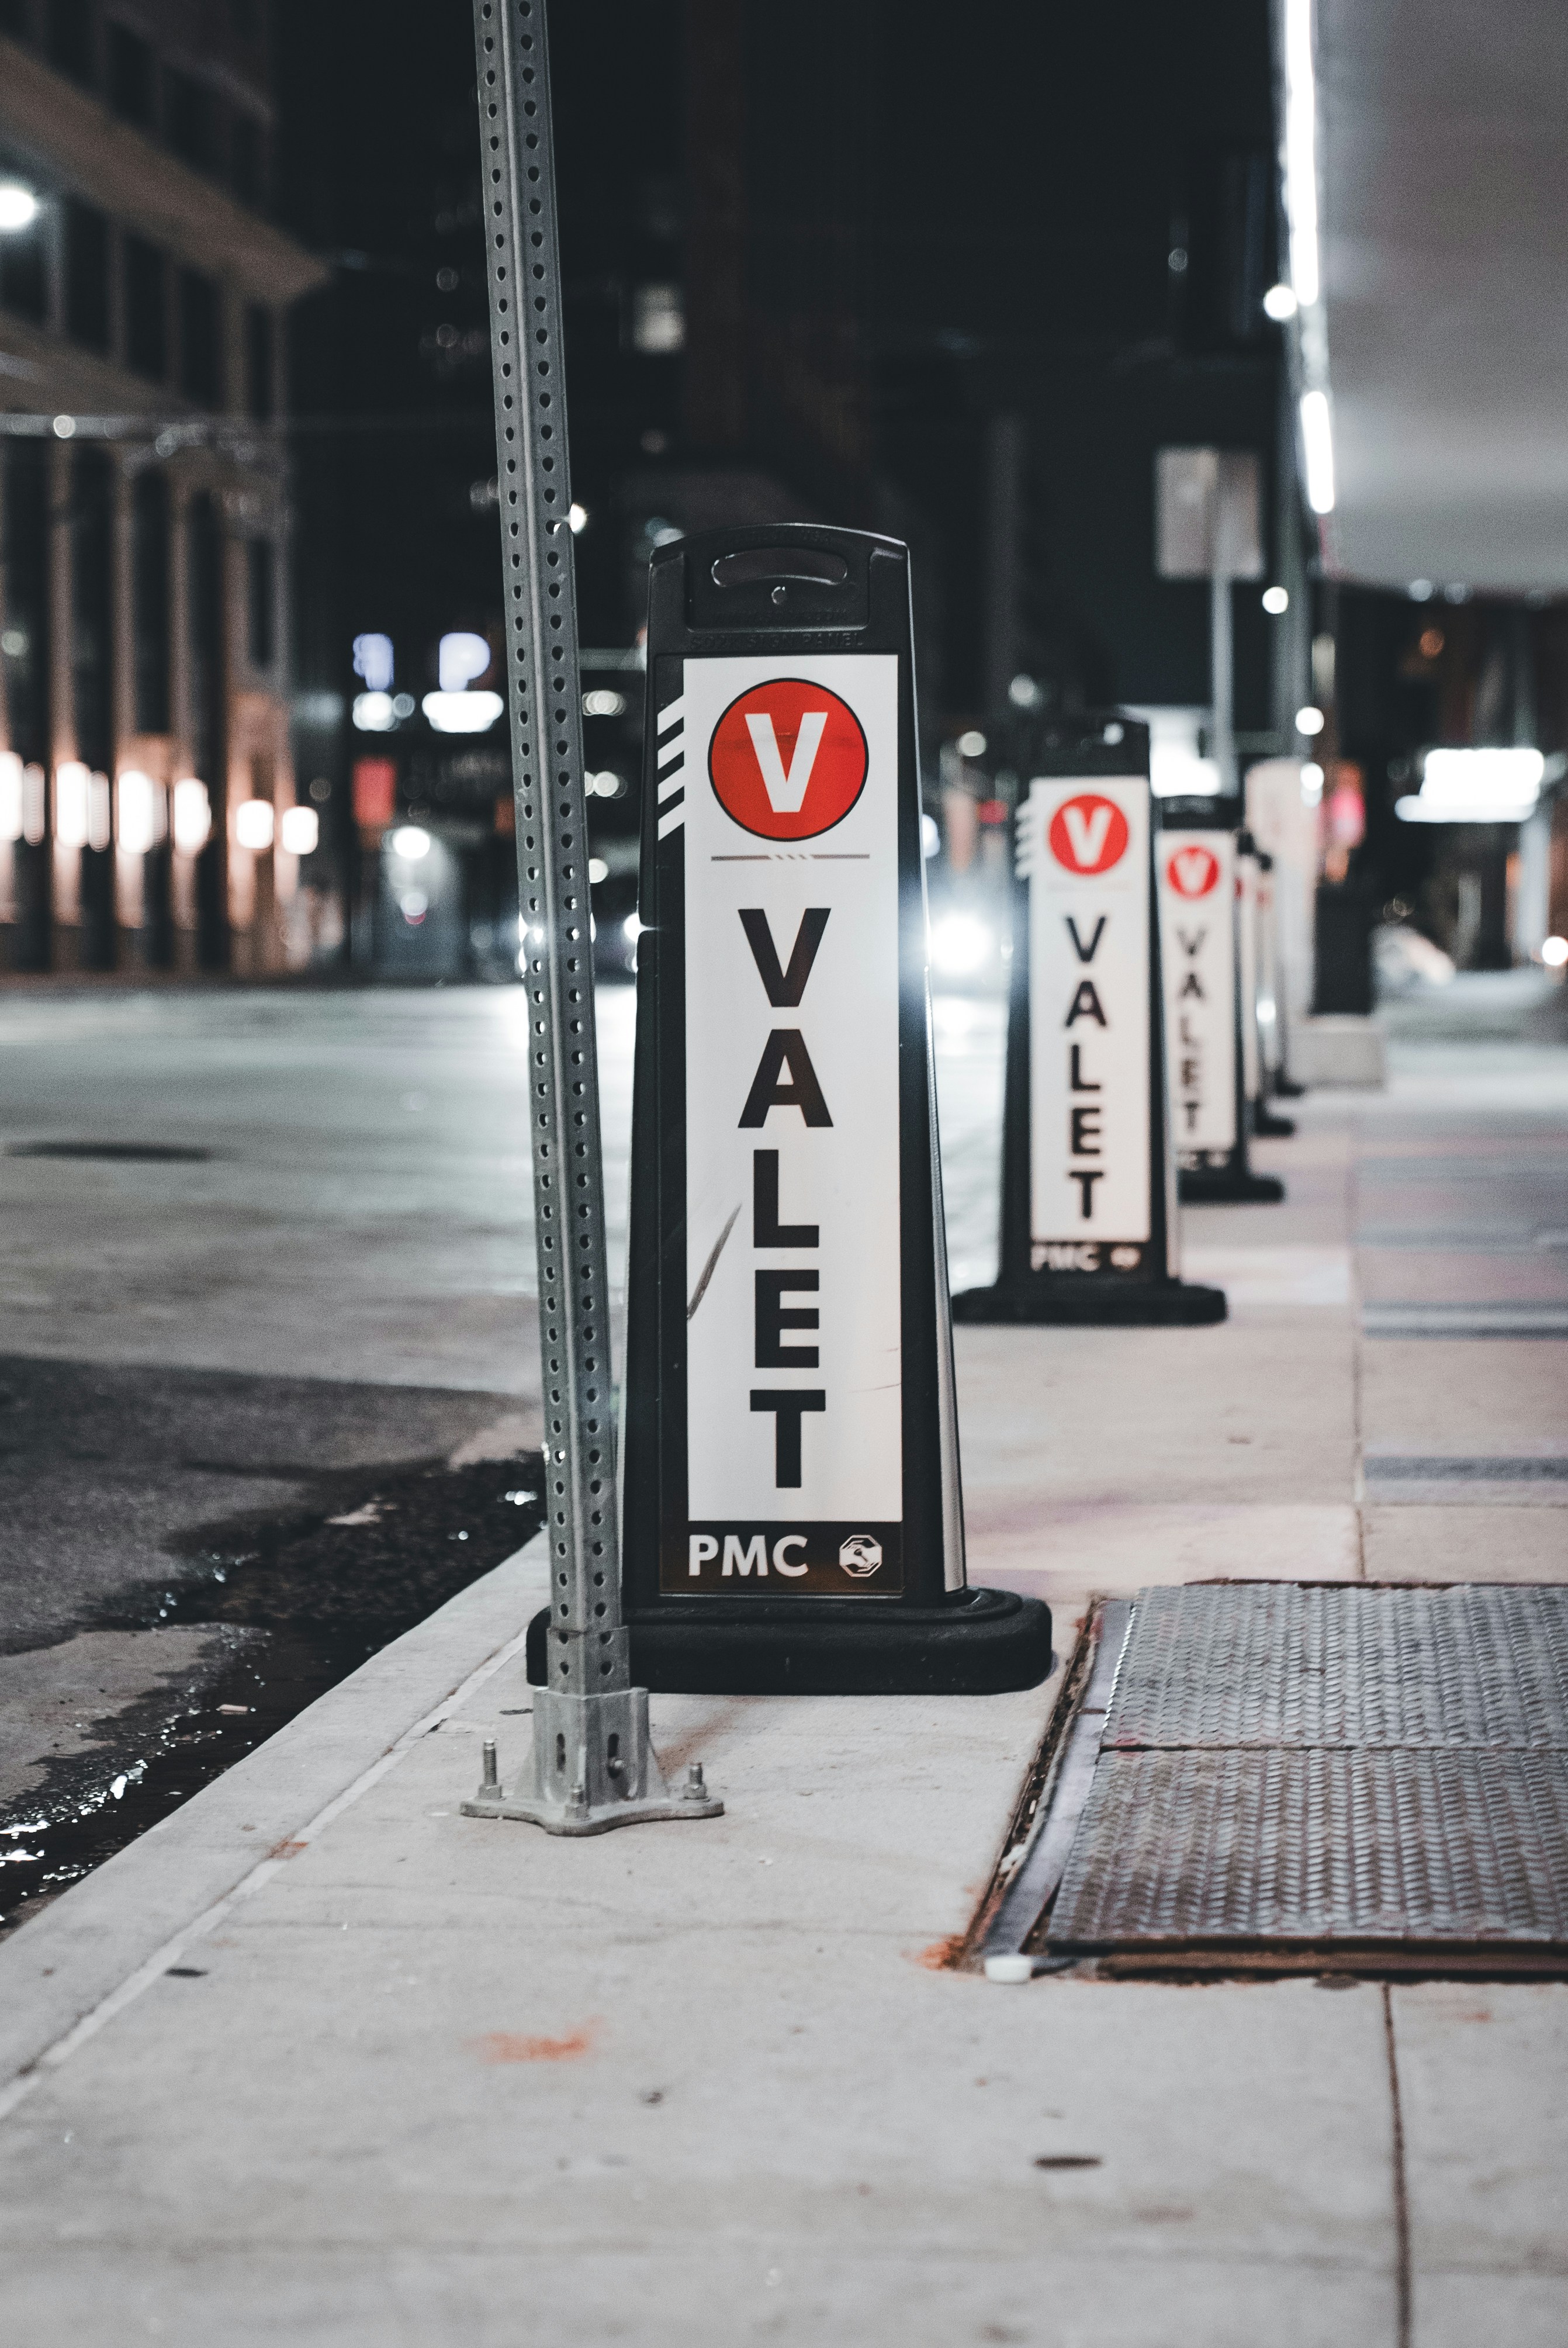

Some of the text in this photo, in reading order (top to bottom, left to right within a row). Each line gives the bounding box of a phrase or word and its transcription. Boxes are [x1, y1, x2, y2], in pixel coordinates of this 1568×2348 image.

[802, 632, 864, 646] PANEL
[744, 711, 829, 813] V
[1063, 805, 1113, 866] V
[1064, 915, 1108, 1219] VALET
[738, 908, 834, 1489] VALET
[1030, 1244, 1100, 1272] PMC
[688, 1534, 809, 1577] PMC
